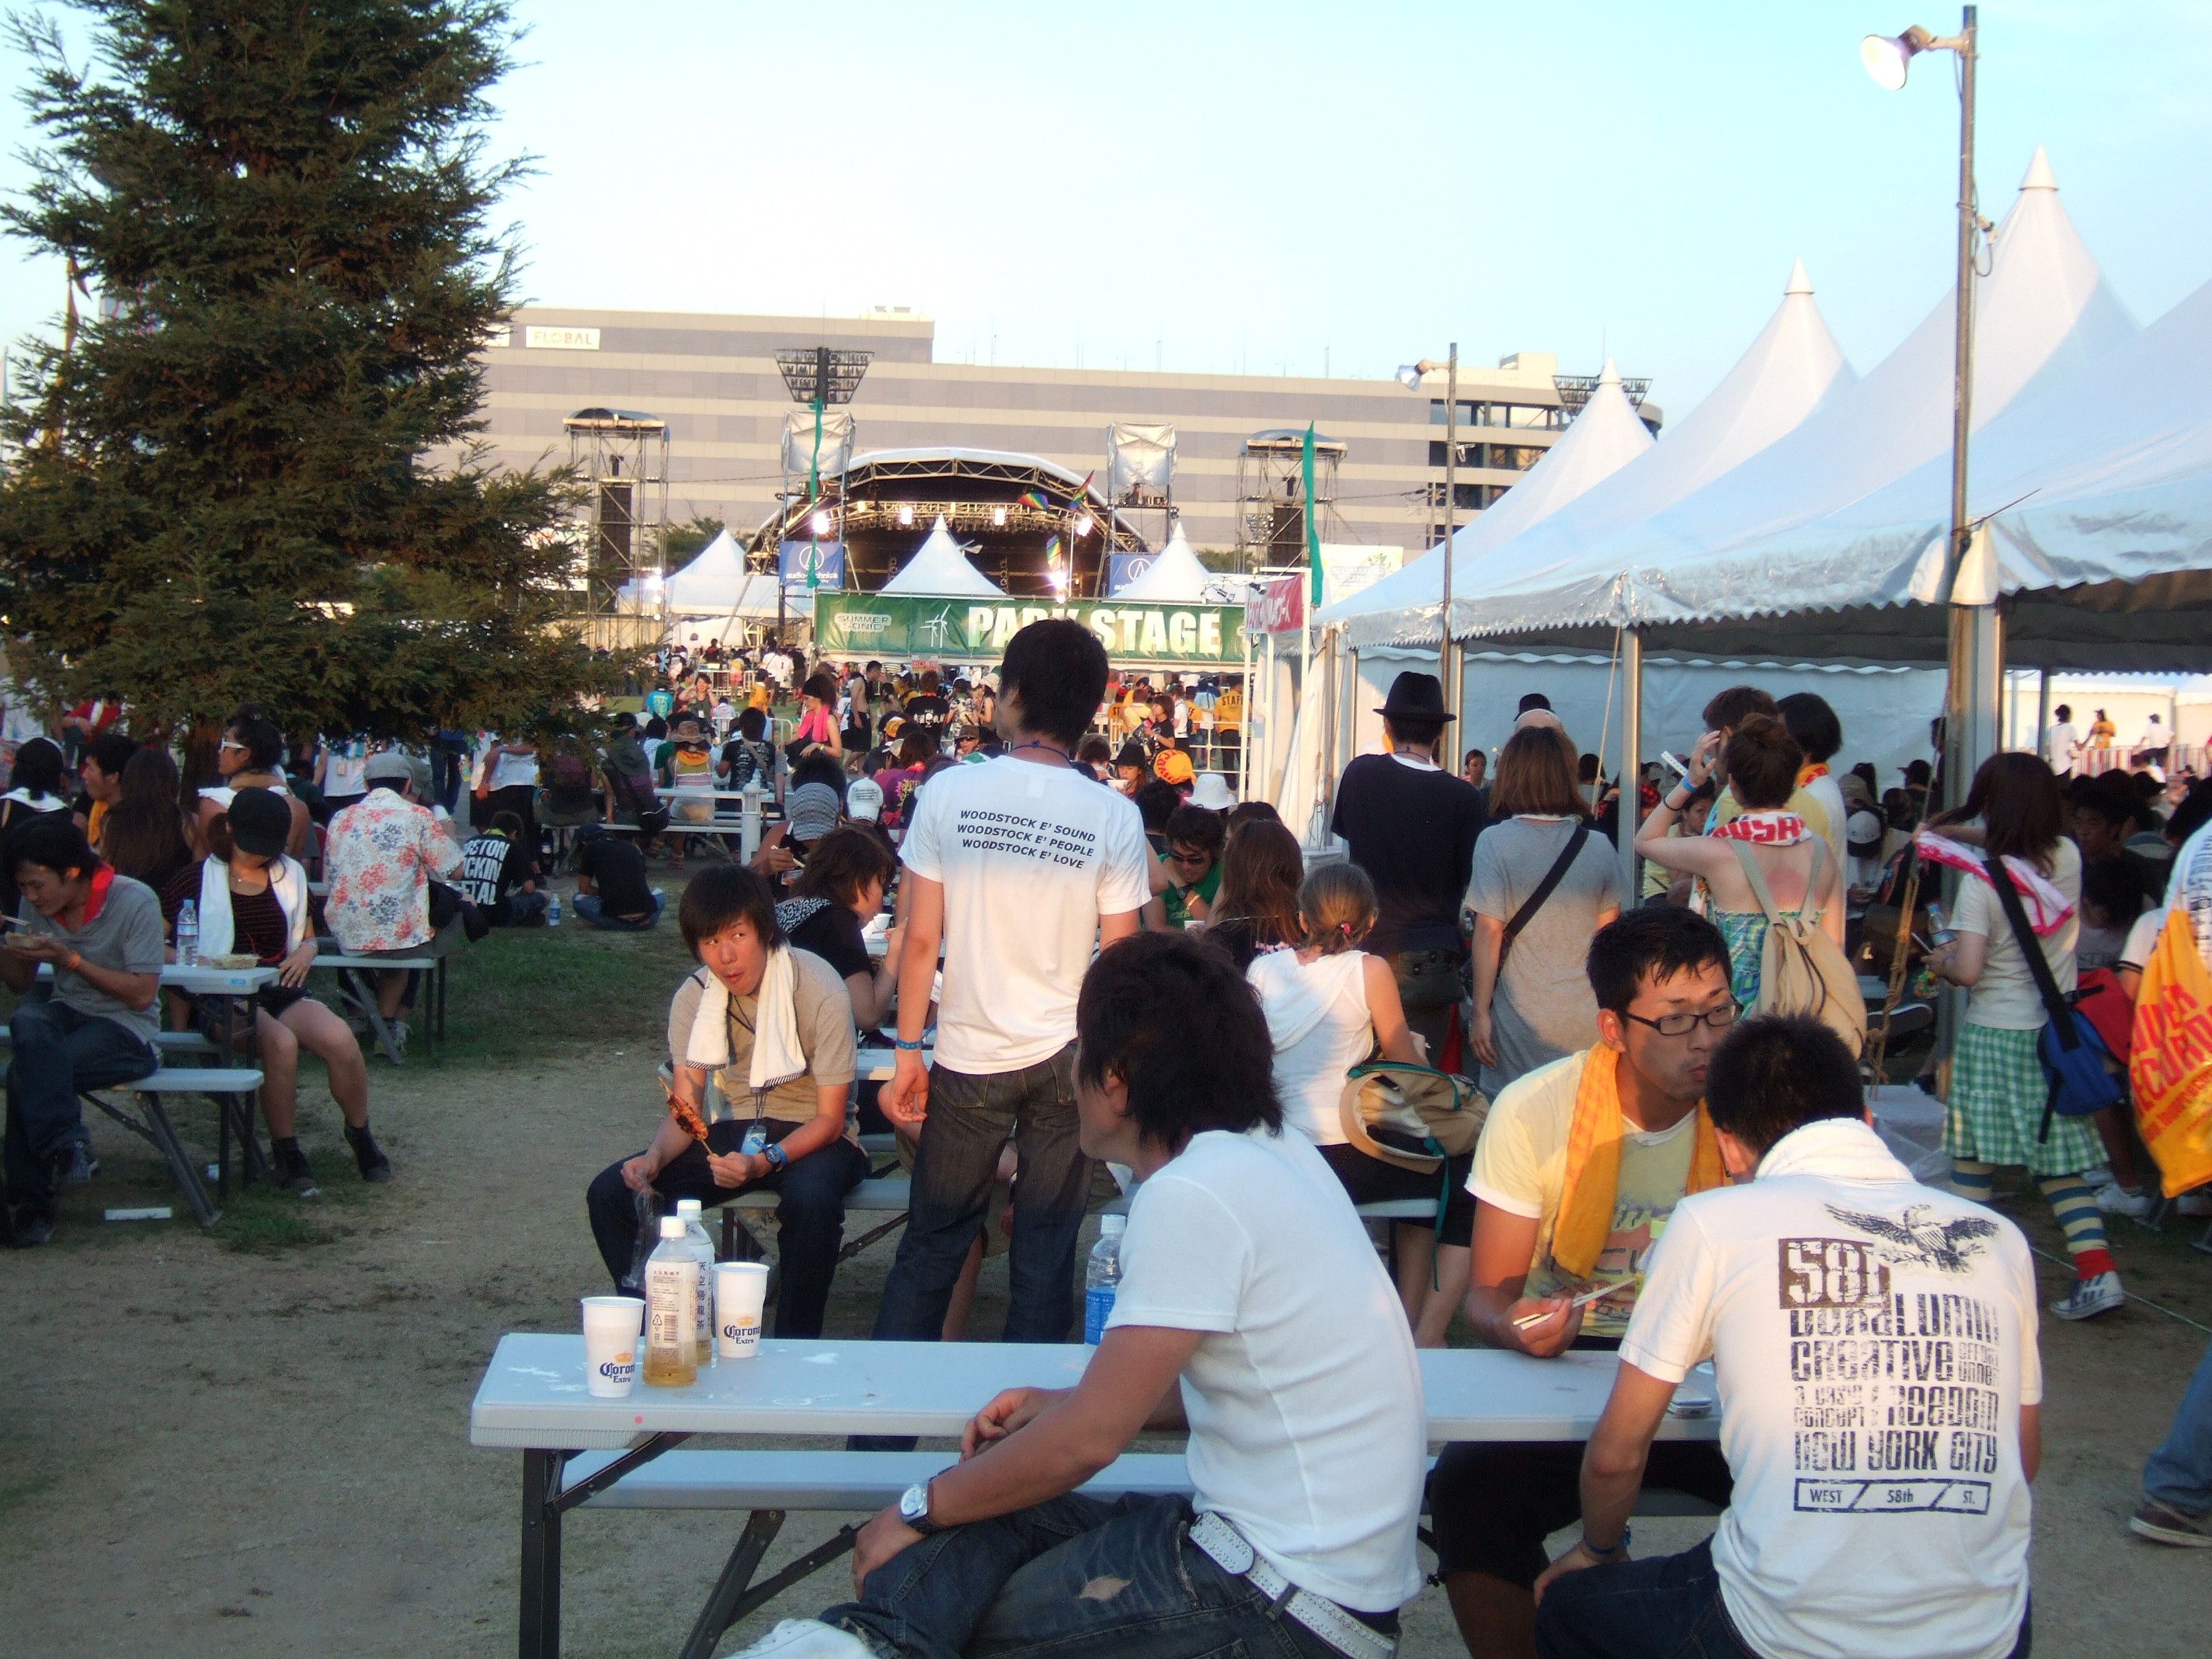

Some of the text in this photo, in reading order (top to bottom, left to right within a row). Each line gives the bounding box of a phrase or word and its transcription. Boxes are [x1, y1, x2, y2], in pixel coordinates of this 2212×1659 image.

[837, 615, 890, 624] SUMMER
[1090, 609, 1222, 654] STAGE
[957, 824, 1033, 842] WOODSTOCK
[1049, 838, 1095, 857] PEOPLE
[960, 809, 1038, 829] WOODSTOCK
[1054, 825, 1097, 843] SOUND
[962, 839, 1038, 857] WOODSTOCK
[1053, 854, 1085, 869] LOVE
[1867, 1430, 1939, 1471] YORK
[1949, 1431, 1998, 1474] CITY
[1810, 1489, 1844, 1504] WEST
[1887, 1489, 1914, 1504] 58th
